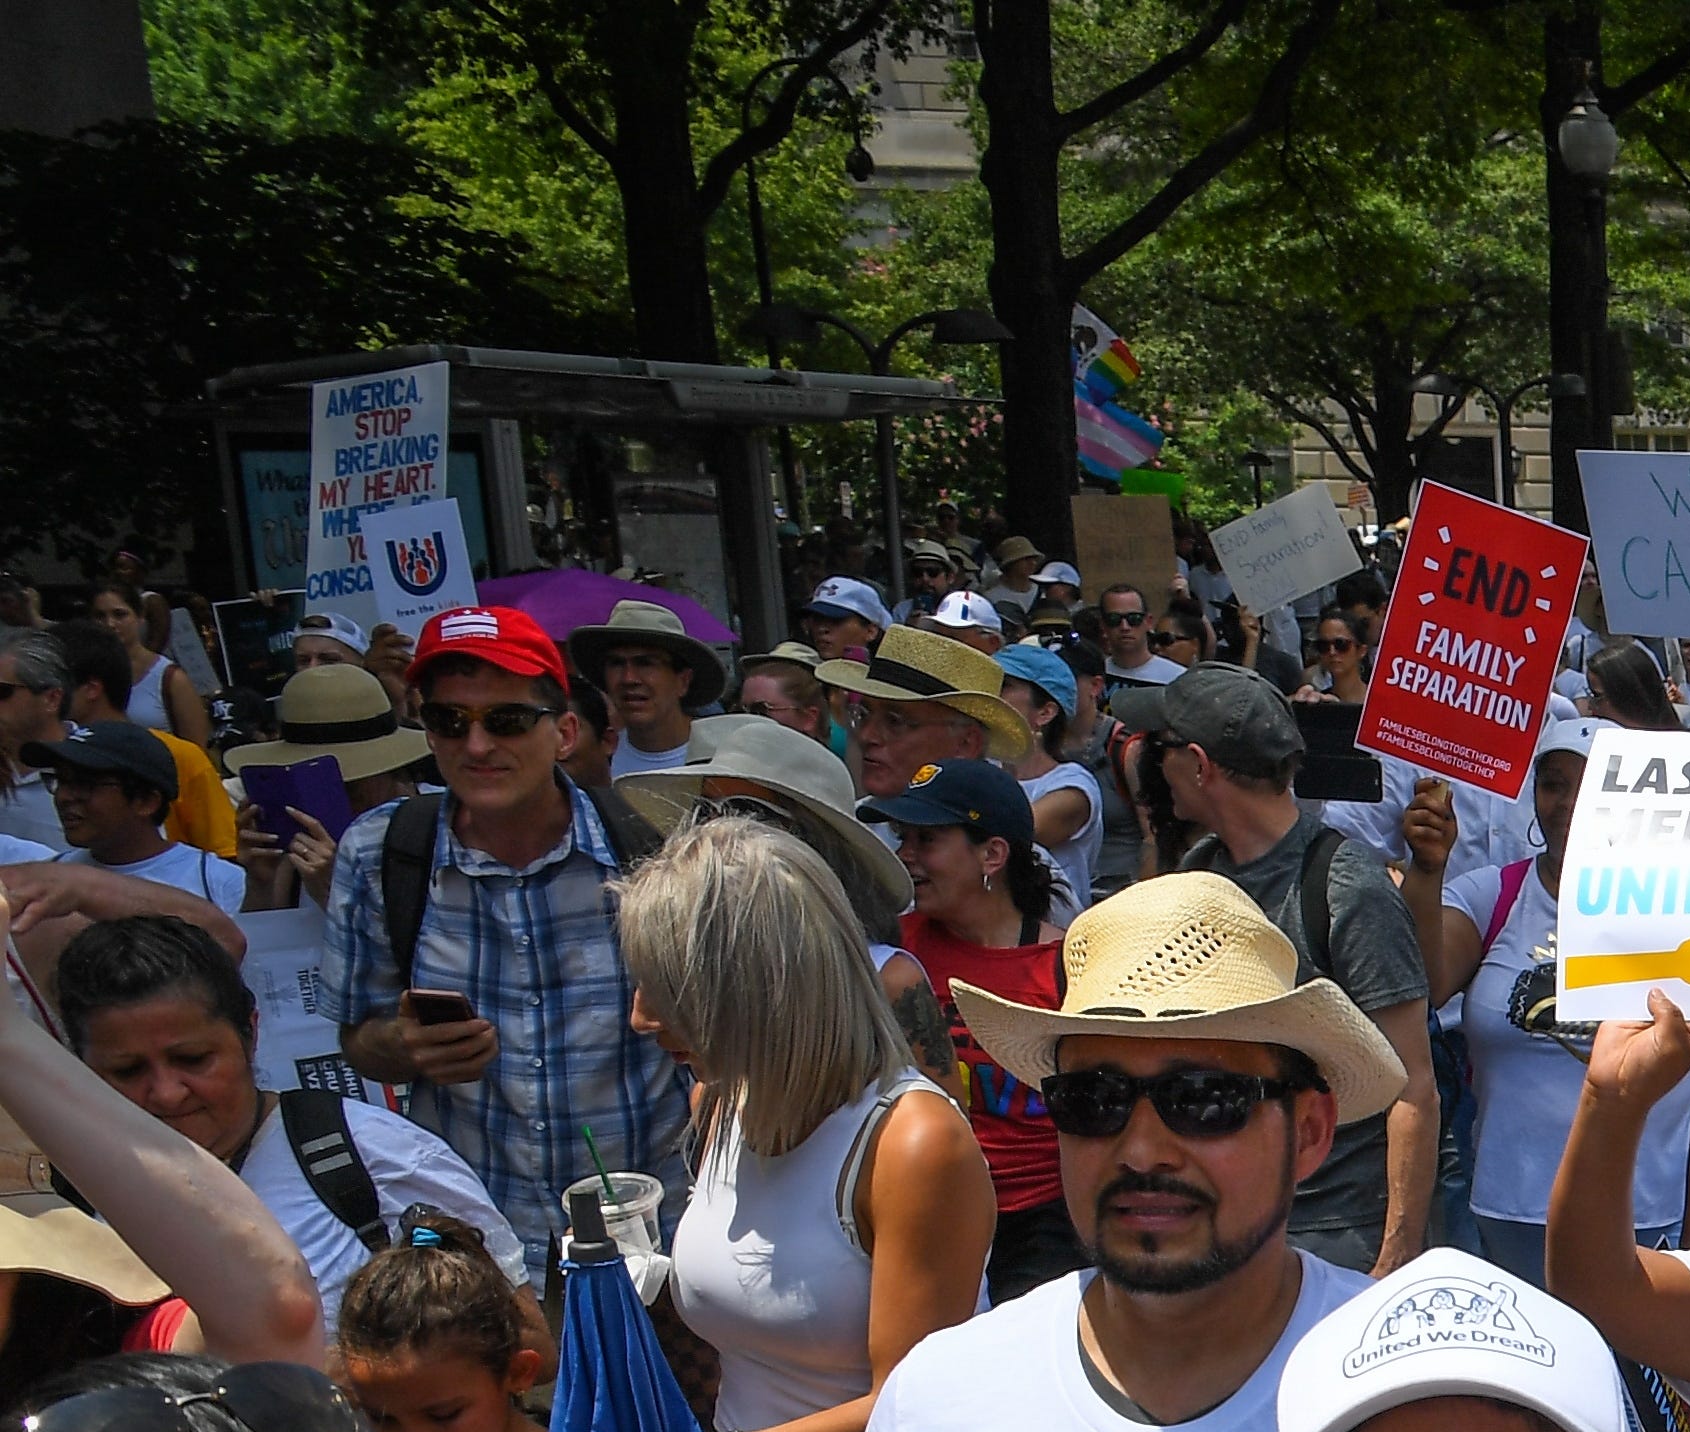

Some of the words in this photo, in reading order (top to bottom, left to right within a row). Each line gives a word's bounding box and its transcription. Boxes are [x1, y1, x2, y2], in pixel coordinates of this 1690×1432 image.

[325, 375, 423, 418] AMERICA,
[355, 408, 411, 440] STOP
[335, 434, 439, 476] BREAKING
[319, 477, 350, 509] MY
[363, 463, 437, 503] HEART.
[1443, 547, 1533, 618] END
[1415, 620, 1526, 687] FAMILY
[1385, 656, 1533, 732] SEPARATION
[1376, 730, 1496, 780] #FAMILIESBELONGTOGETHER
[1378, 716, 1512, 773] FAMILIESBELONGTOGETHER.ORG
[1351, 1333, 1422, 1370] United
[1426, 1329, 1467, 1344] We
[1470, 1329, 1548, 1359] Dream
